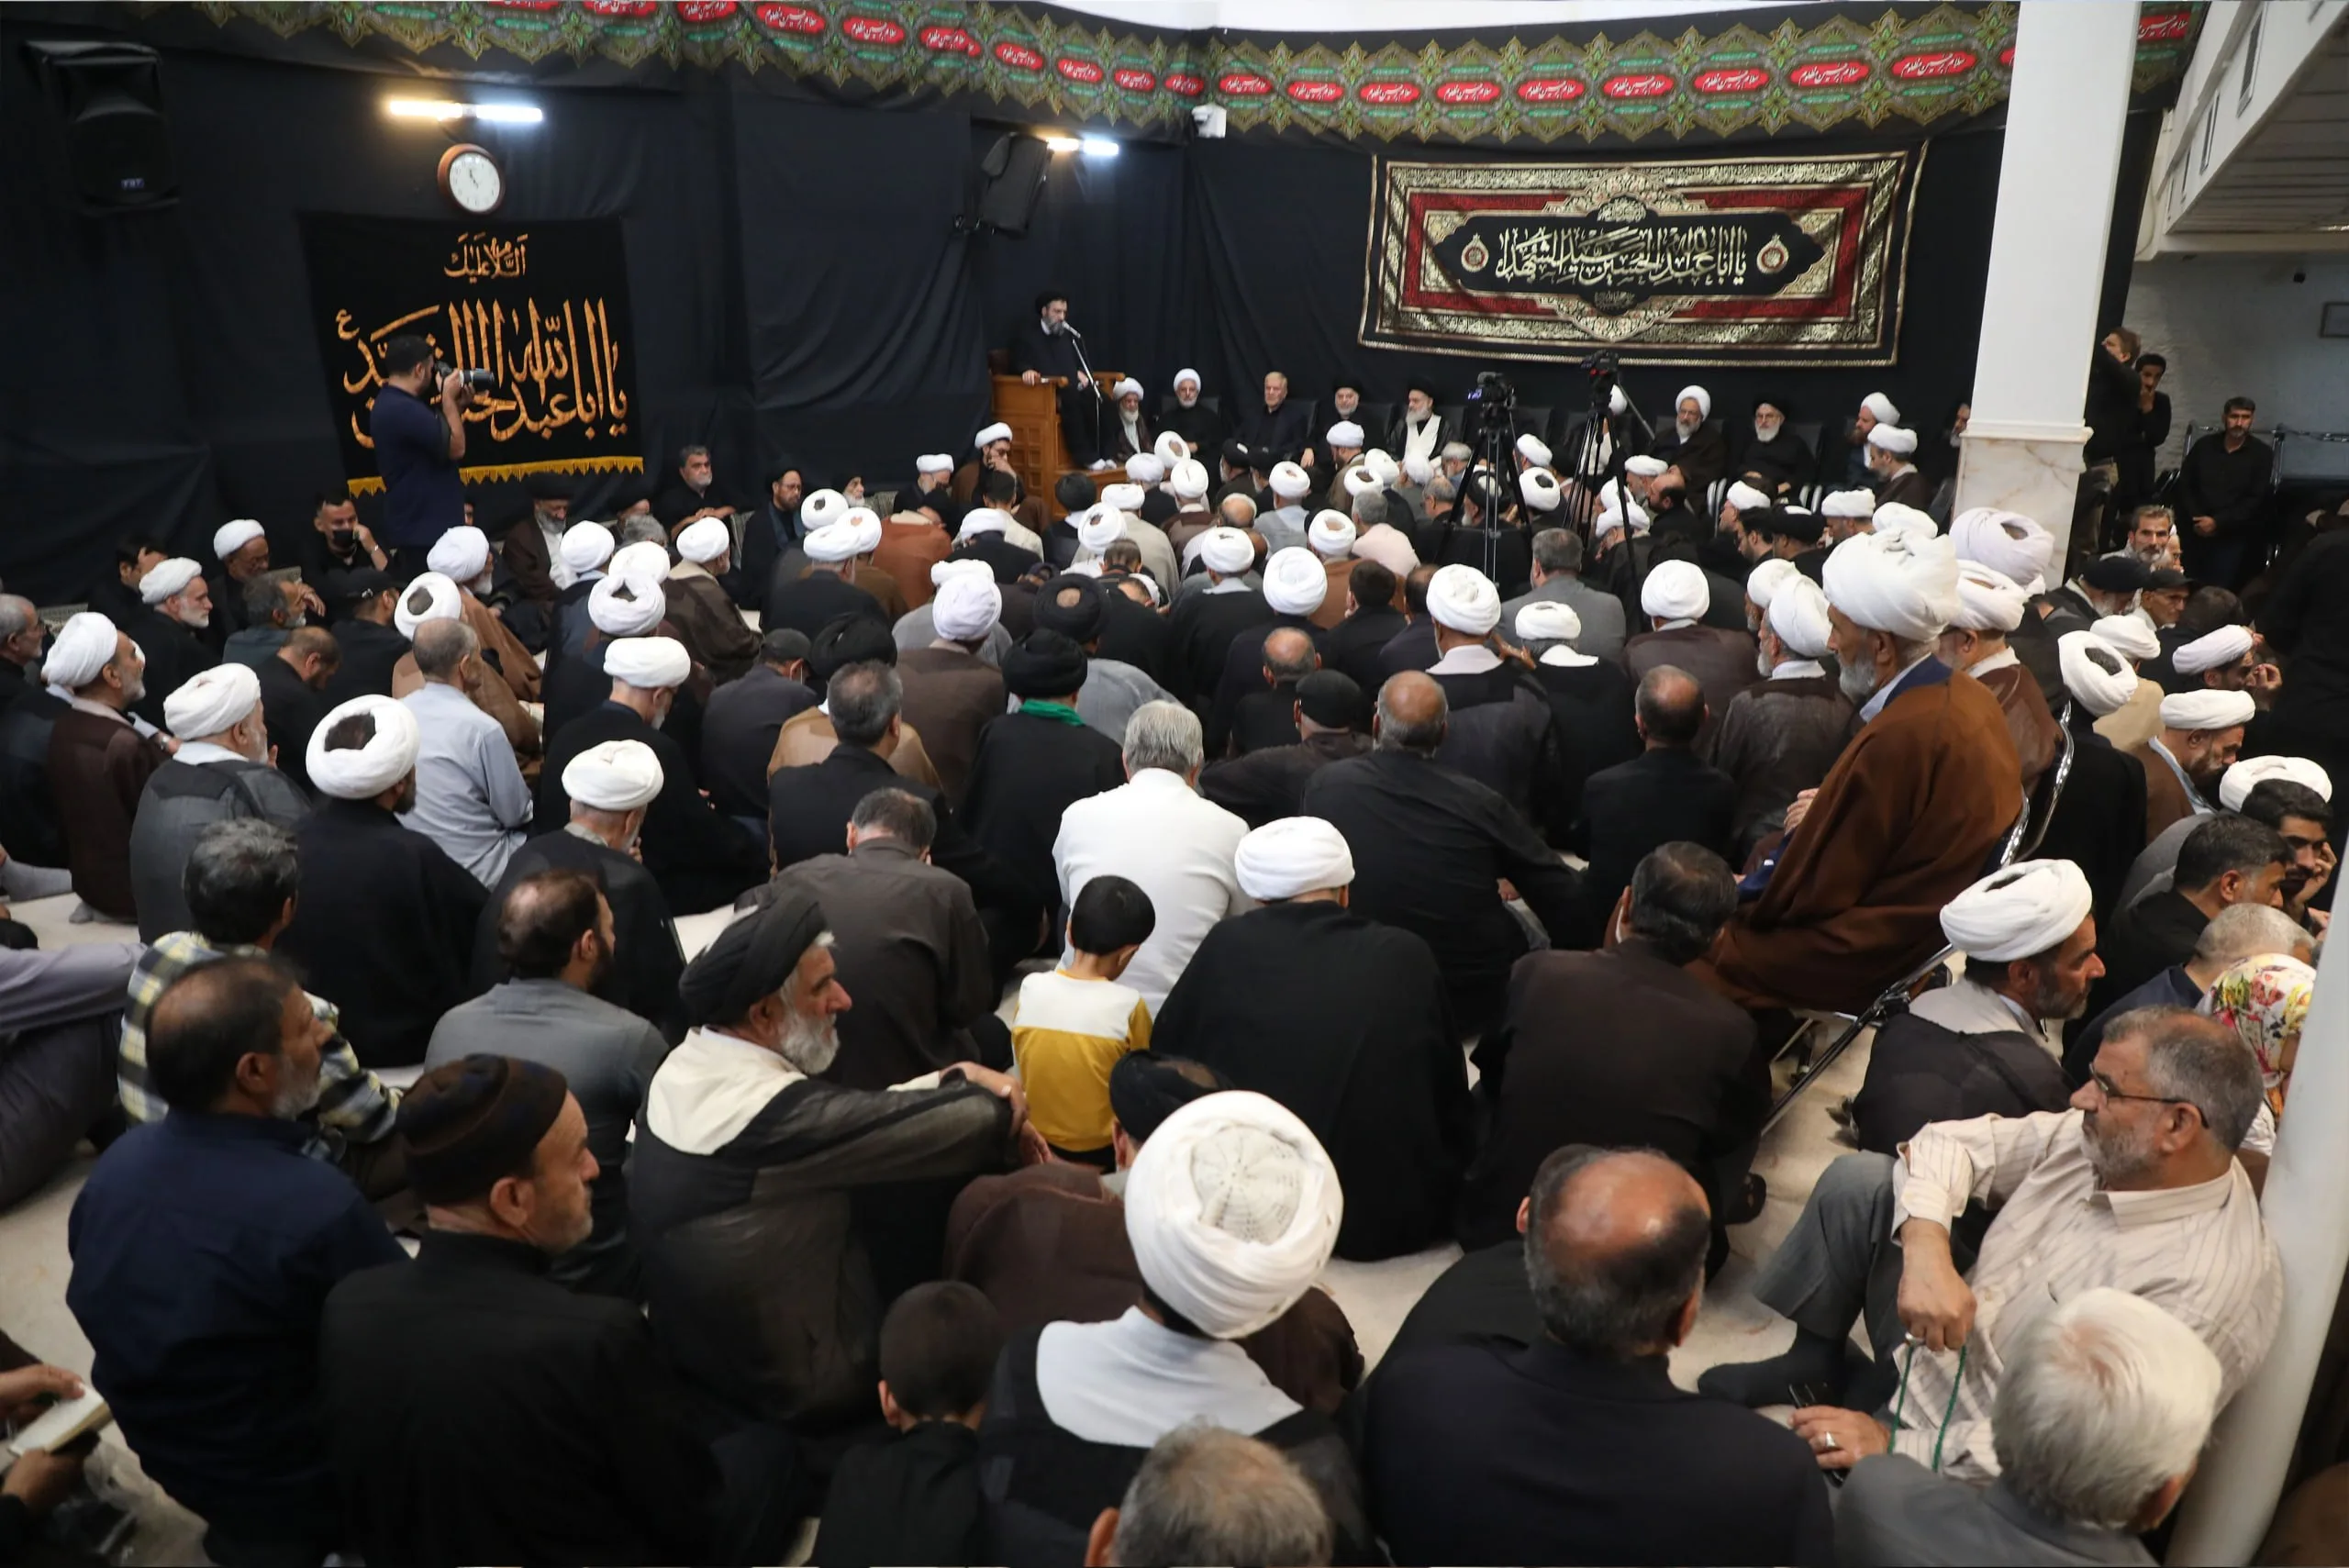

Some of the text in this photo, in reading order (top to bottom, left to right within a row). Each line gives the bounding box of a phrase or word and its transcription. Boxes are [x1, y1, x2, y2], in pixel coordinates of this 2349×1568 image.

[1798, 66, 1819, 87] مظلوم
[1900, 58, 1922, 78] مظلوم
[1525, 83, 1542, 100] مظلوم
[1611, 78, 1630, 96] مظلوم
[1702, 73, 1721, 92] مظلوم
[1443, 84, 1460, 101] مظلوم
